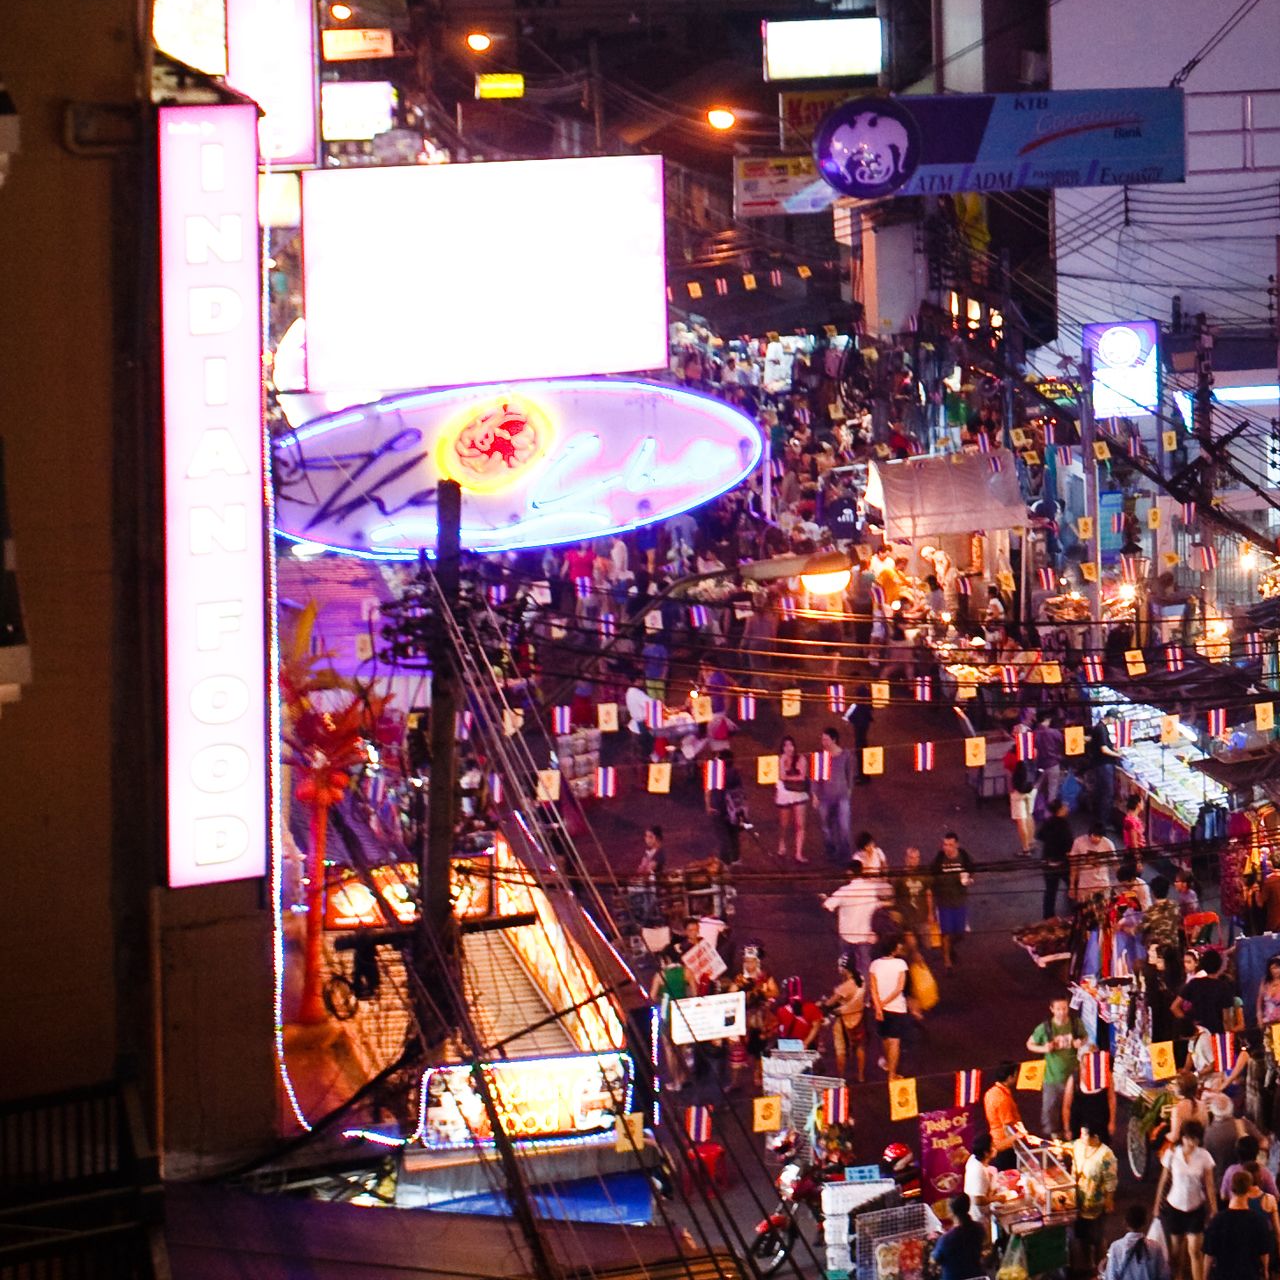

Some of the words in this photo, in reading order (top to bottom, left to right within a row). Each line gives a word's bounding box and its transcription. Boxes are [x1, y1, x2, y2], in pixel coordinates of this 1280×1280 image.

[1113, 127, 1143, 139] Bank
[917, 174, 953, 191] ATM
[973, 172, 1013, 190] ADM
[184, 140, 250, 555] INDIAN
[188, 599, 251, 868] FOOD
